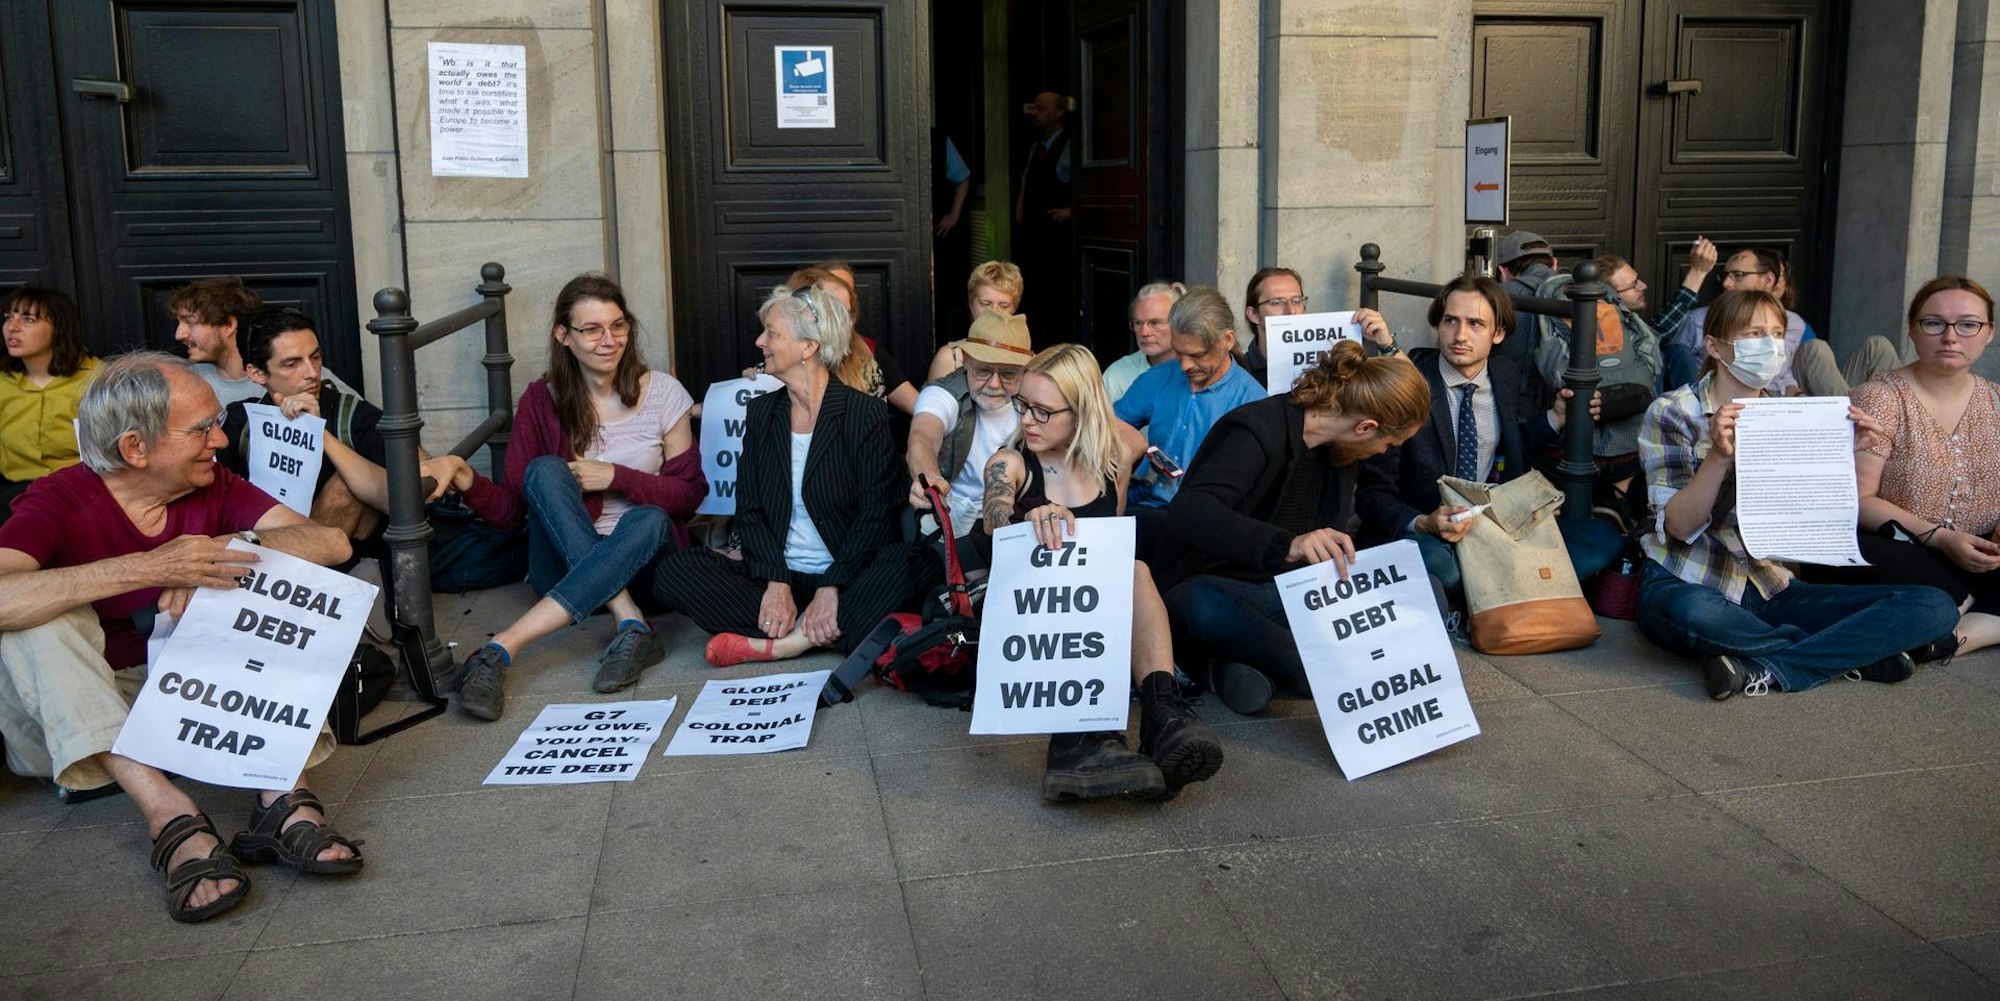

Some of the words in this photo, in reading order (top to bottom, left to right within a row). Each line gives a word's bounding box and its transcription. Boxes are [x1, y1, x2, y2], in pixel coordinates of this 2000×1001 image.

[466, 59, 474, 67] is
[484, 60, 491, 68] it
[438, 70, 470, 79] actually
[478, 80, 501, 88] debt?
[473, 108, 504, 116] possible
[440, 116, 468, 125] Europe
[1475, 146, 1498, 156] Eingang
[1282, 327, 1346, 343] GLOBAL
[1293, 350, 1332, 366] DE
[736, 388, 767, 406] G
[262, 422, 315, 452] GLOBAL
[269, 452, 303, 477] DEBT
[1030, 542, 1087, 568] G7:
[233, 568, 342, 620] GLOBAL
[1304, 564, 1407, 611] GLOBAL
[1014, 585, 1100, 614] WHO
[1332, 600, 1398, 641] DEBT
[233, 608, 316, 650] DEBT
[1002, 631, 1106, 662] OWES
[1370, 648, 1385, 660] =
[245, 658, 264, 673] =
[722, 681, 808, 694] GLOBAL
[1000, 679, 1105, 708] WHO?
[1338, 664, 1442, 714] GLOBAL
[158, 672, 312, 730] COLONIAL
[729, 694, 792, 706] DEBT
[584, 710, 627, 720] G7
[688, 714, 806, 731] COLONIAL
[1357, 698, 1444, 744] CRIME
[594, 722, 652, 732] OWE,
[176, 718, 266, 756] TRAP
[709, 734, 776, 744] TRAP
[524, 747, 628, 760] CANCEL
[504, 765, 556, 776] THE
[561, 763, 633, 774] DEBT
